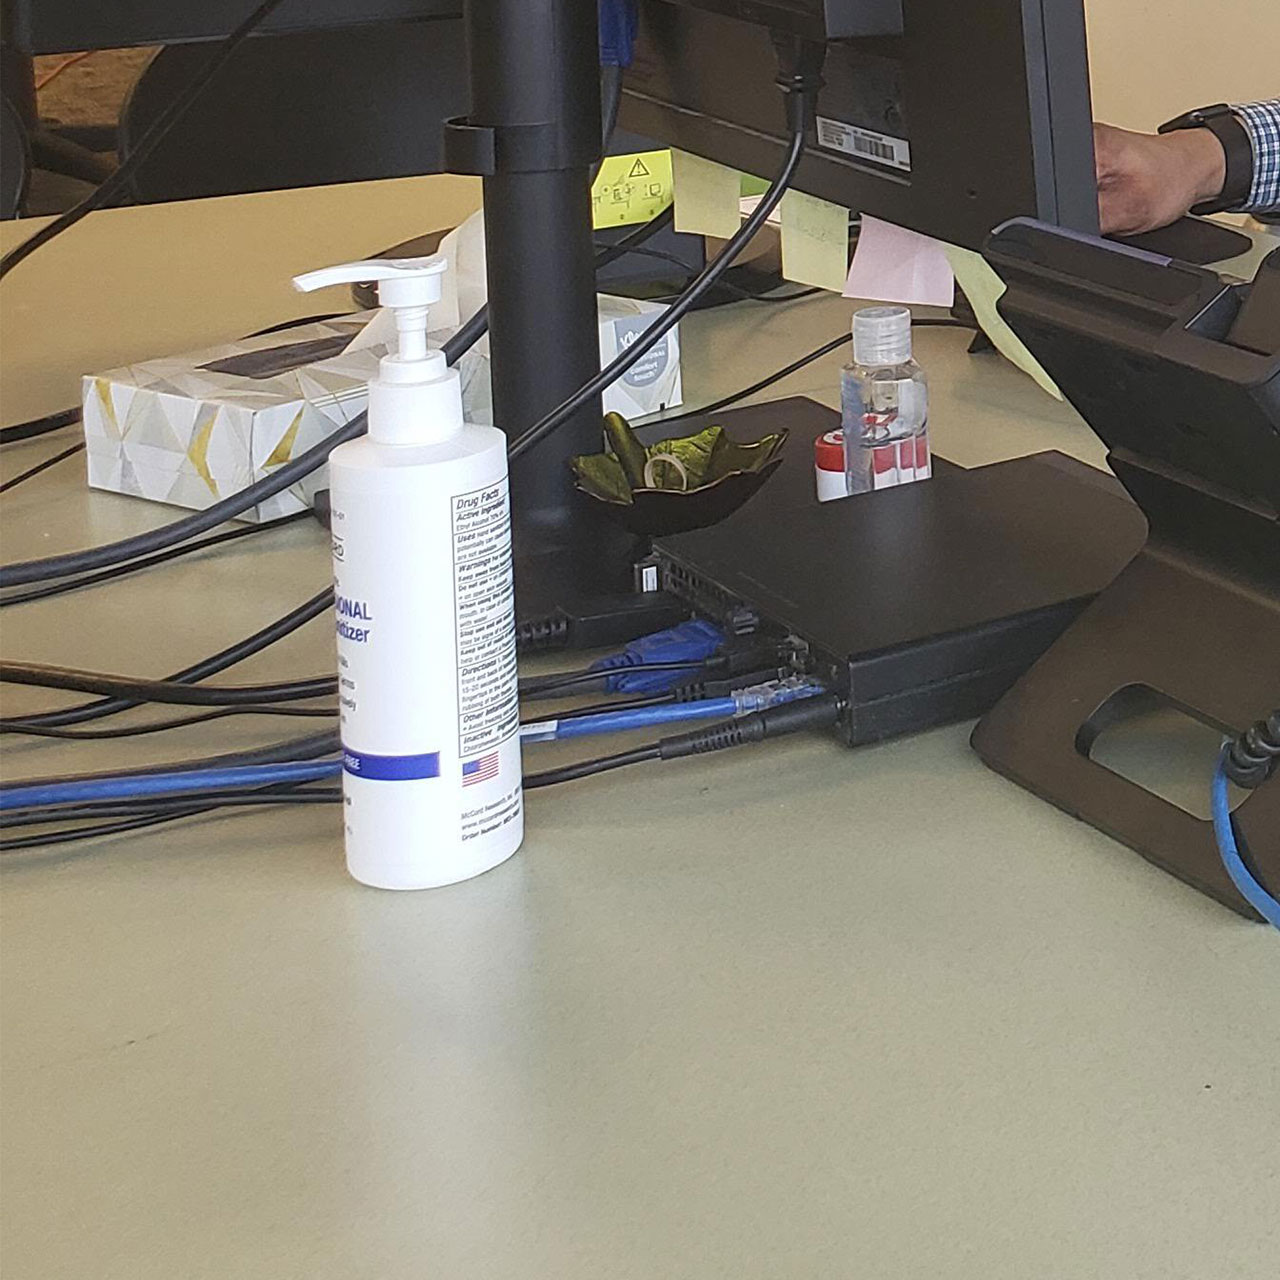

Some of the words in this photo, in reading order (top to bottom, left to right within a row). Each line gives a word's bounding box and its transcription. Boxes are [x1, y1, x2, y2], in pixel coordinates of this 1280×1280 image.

[456, 497, 479, 510] Drug
[481, 489, 499, 503] Facts
[456, 511, 479, 522] Active
[457, 533, 476, 543] Uses
[459, 558, 491, 572] Warnings
[462, 659, 496, 677] Directions
[463, 711, 484, 723] Other
[464, 729, 492, 744] Inactive
